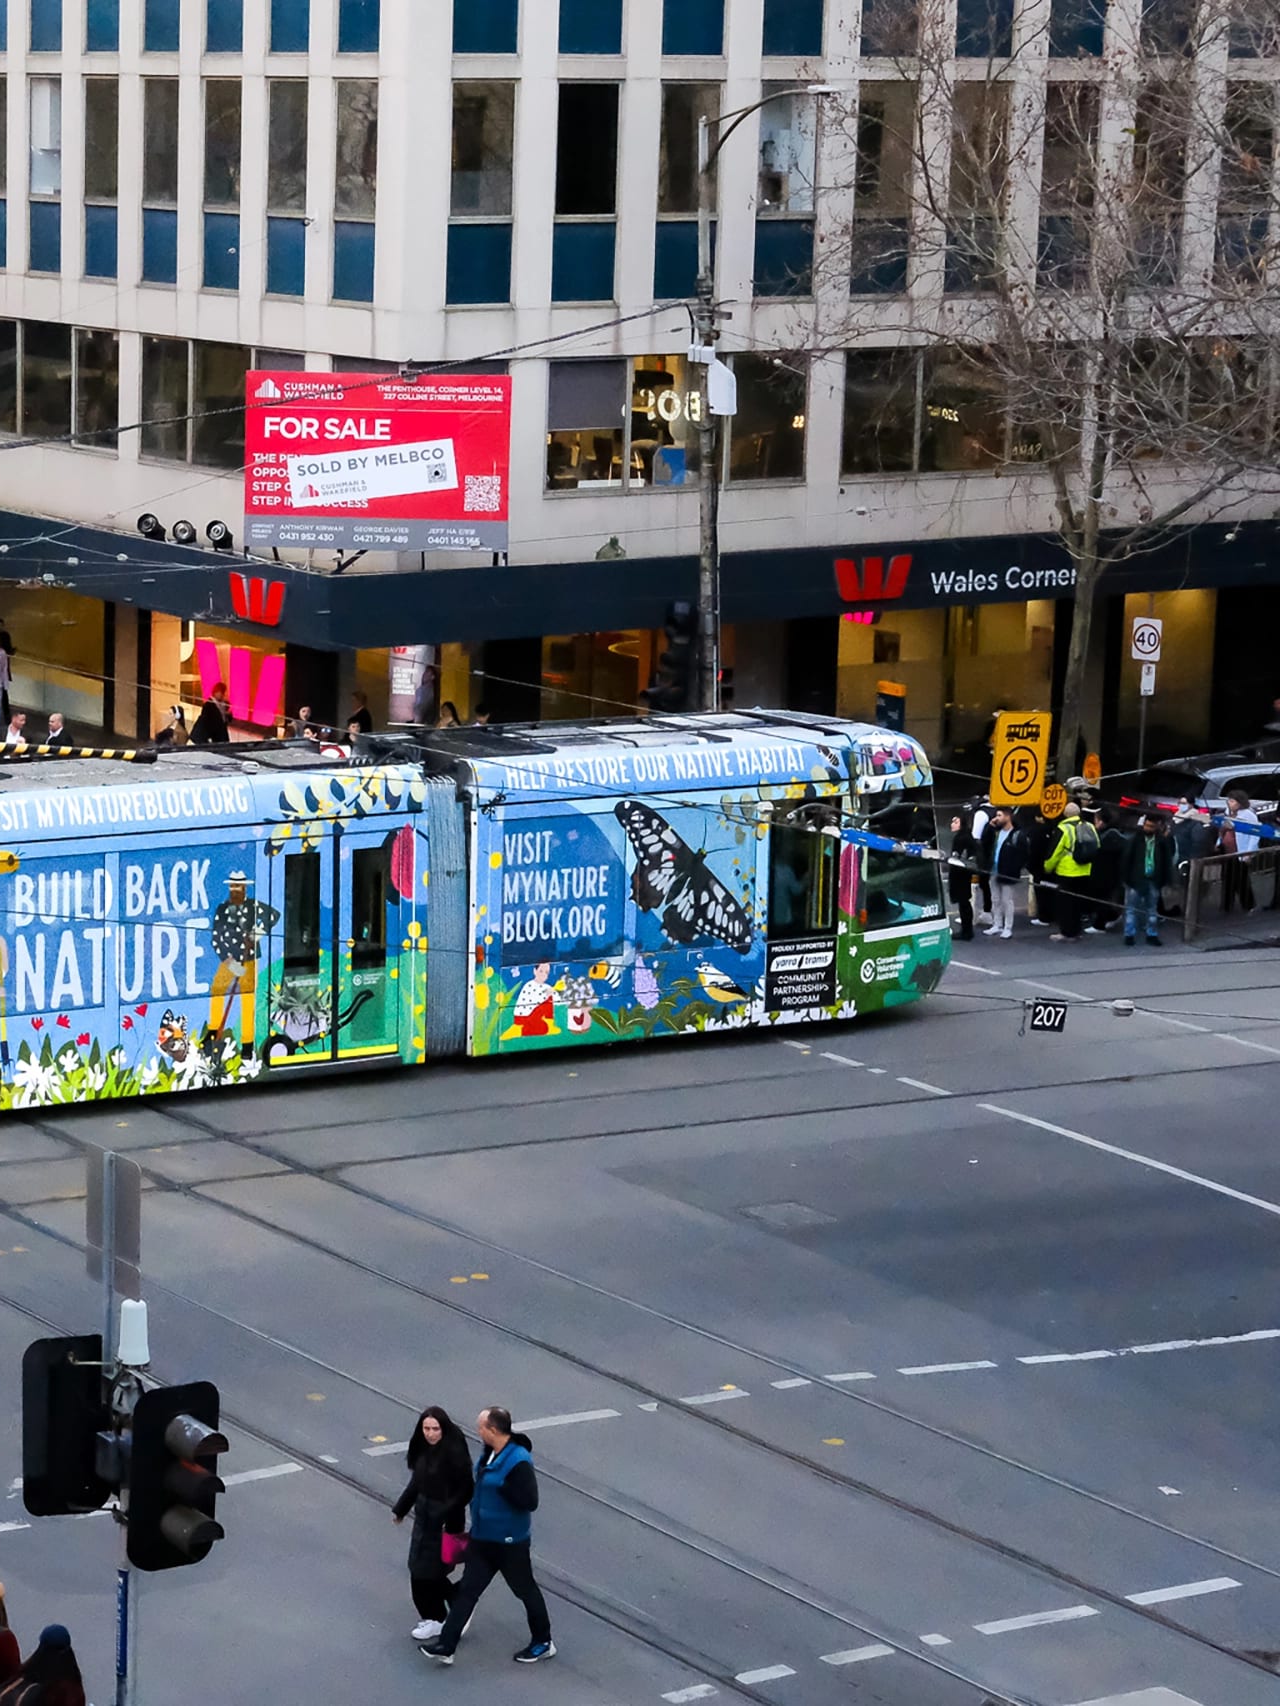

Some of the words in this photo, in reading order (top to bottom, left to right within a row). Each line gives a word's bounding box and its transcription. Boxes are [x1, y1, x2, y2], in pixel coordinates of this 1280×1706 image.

[284, 382, 337, 391] CUSHMAN
[393, 386, 437, 394] PENTHOUSE,
[284, 391, 344, 400] WAKEFIELD
[263, 416, 319, 439] FOR
[324, 417, 391, 440] SALE
[252, 453, 276, 463] THE
[297, 460, 341, 476] SOLD
[348, 457, 368, 471] BY
[374, 447, 444, 466] MELBCO
[252, 481, 281, 491] STEP
[321, 481, 359, 490] CUSHMAN
[322, 486, 367, 496] WAKEFIELD
[252, 495, 281, 506] STEP
[279, 532, 299, 540] 0431
[301, 533, 316, 541] 952
[353, 534, 373, 543] 0421
[930, 568, 998, 594] Wales
[1005, 566, 1077, 589] Corner
[1136, 631, 1157, 647] 40
[506, 760, 549, 790] HELP
[556, 754, 630, 788] RESTORE
[633, 752, 670, 782] OUR
[673, 748, 731, 780] NATIVE
[737, 745, 806, 774] HABITAT
[1009, 759, 1029, 783] 15
[1044, 789, 1064, 800] CUT
[35, 782, 249, 830] MYNATUREBLOCK.ORG
[1043, 803, 1063, 814] OFF
[504, 831, 553, 865] VISIT
[503, 865, 609, 905] MYNATURE
[15, 868, 112, 927] BUILD
[126, 859, 210, 917] BACK
[503, 904, 606, 943] BLOCK.ORG
[796, 942, 826, 950] SUPPORTED
[15, 918, 209, 1012] NATURE
[775, 959, 797, 970] yarra
[805, 955, 829, 965] trams
[777, 972, 826, 984] COMMUNITY
[773, 984, 829, 995] PARTNERSHIPS
[782, 995, 820, 1006] PROGRAM
[1033, 1006, 1065, 1026] 207
